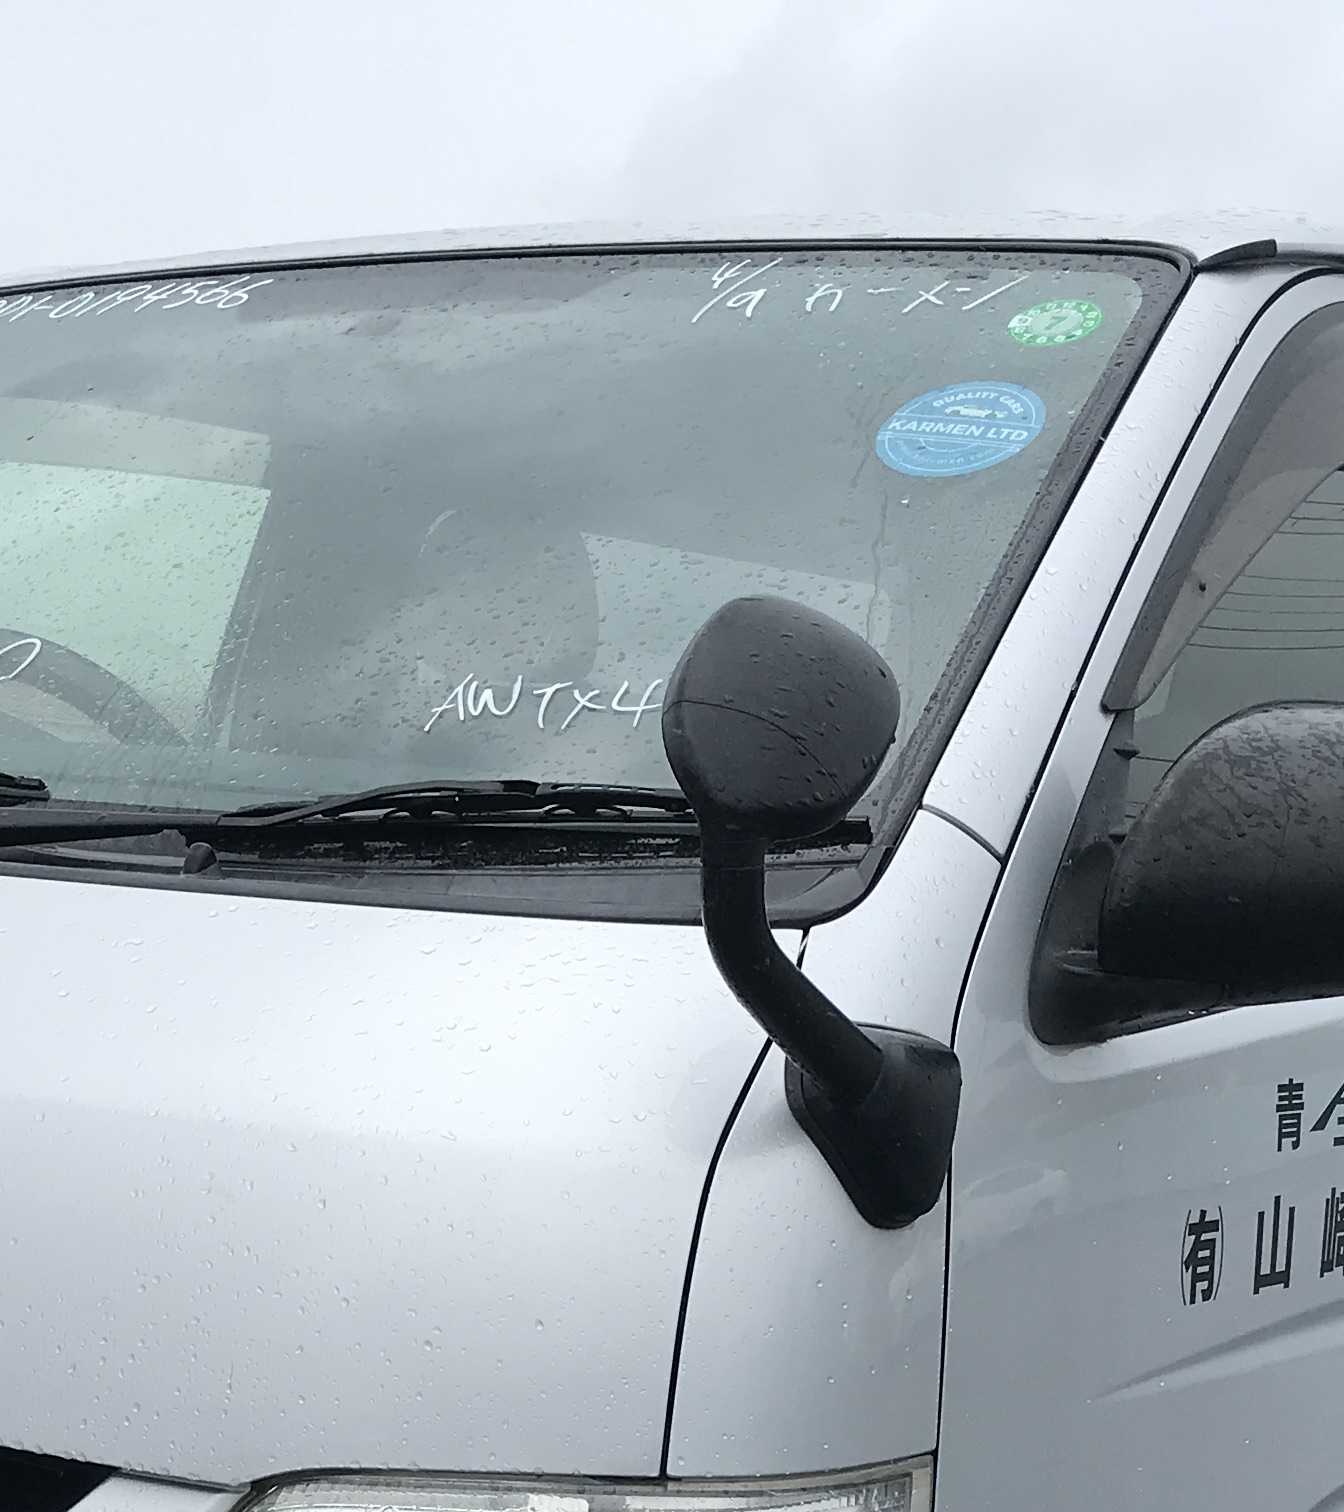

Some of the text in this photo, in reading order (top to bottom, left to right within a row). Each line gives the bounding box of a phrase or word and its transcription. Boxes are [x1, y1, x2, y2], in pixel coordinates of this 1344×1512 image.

[932, 391, 998, 408] QUALITY
[887, 417, 1029, 442] KARMEN LTD
